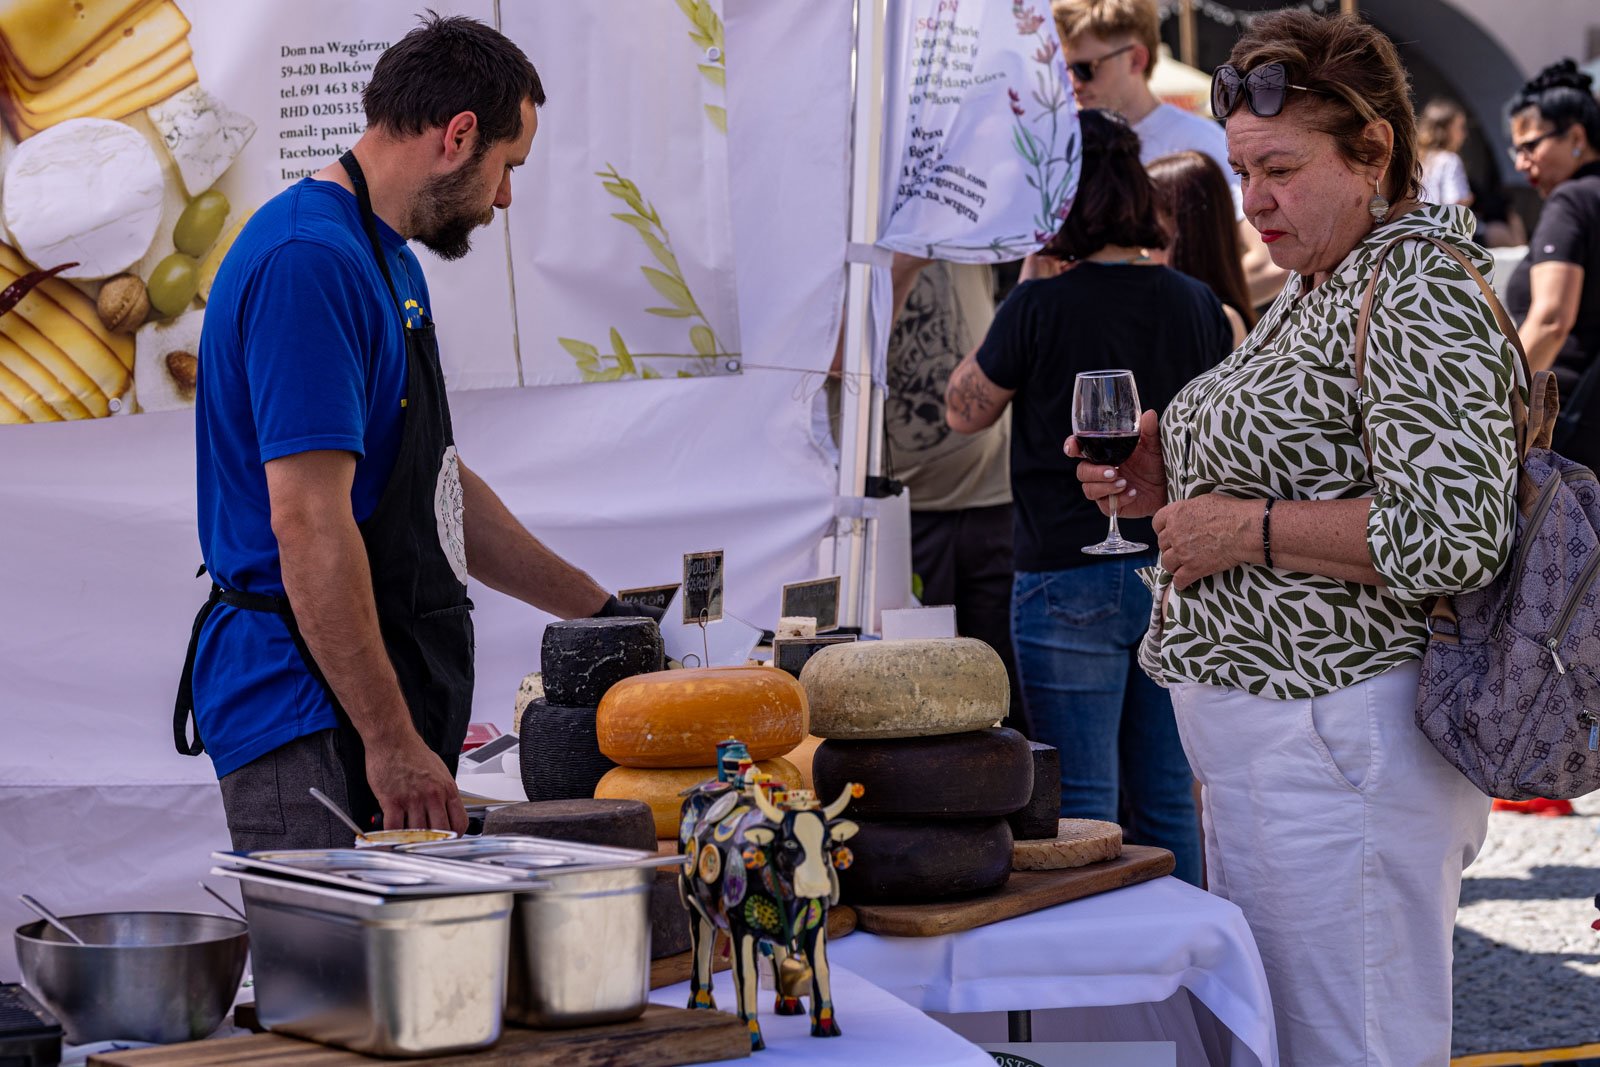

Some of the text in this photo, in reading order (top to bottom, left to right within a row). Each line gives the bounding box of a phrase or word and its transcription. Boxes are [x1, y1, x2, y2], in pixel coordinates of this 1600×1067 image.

[281, 40, 391, 57] Dom na Wzgórzu
[281, 61, 374, 78] 59-420 Bolków
[280, 86, 298, 98] tel.
[300, 84, 320, 96] 691
[324, 83, 347, 94] 463
[280, 105, 309, 118] RHD
[279, 124, 318, 139] email:
[281, 168, 321, 180] Insta
[994, 1055, 1034, 1067] OST
